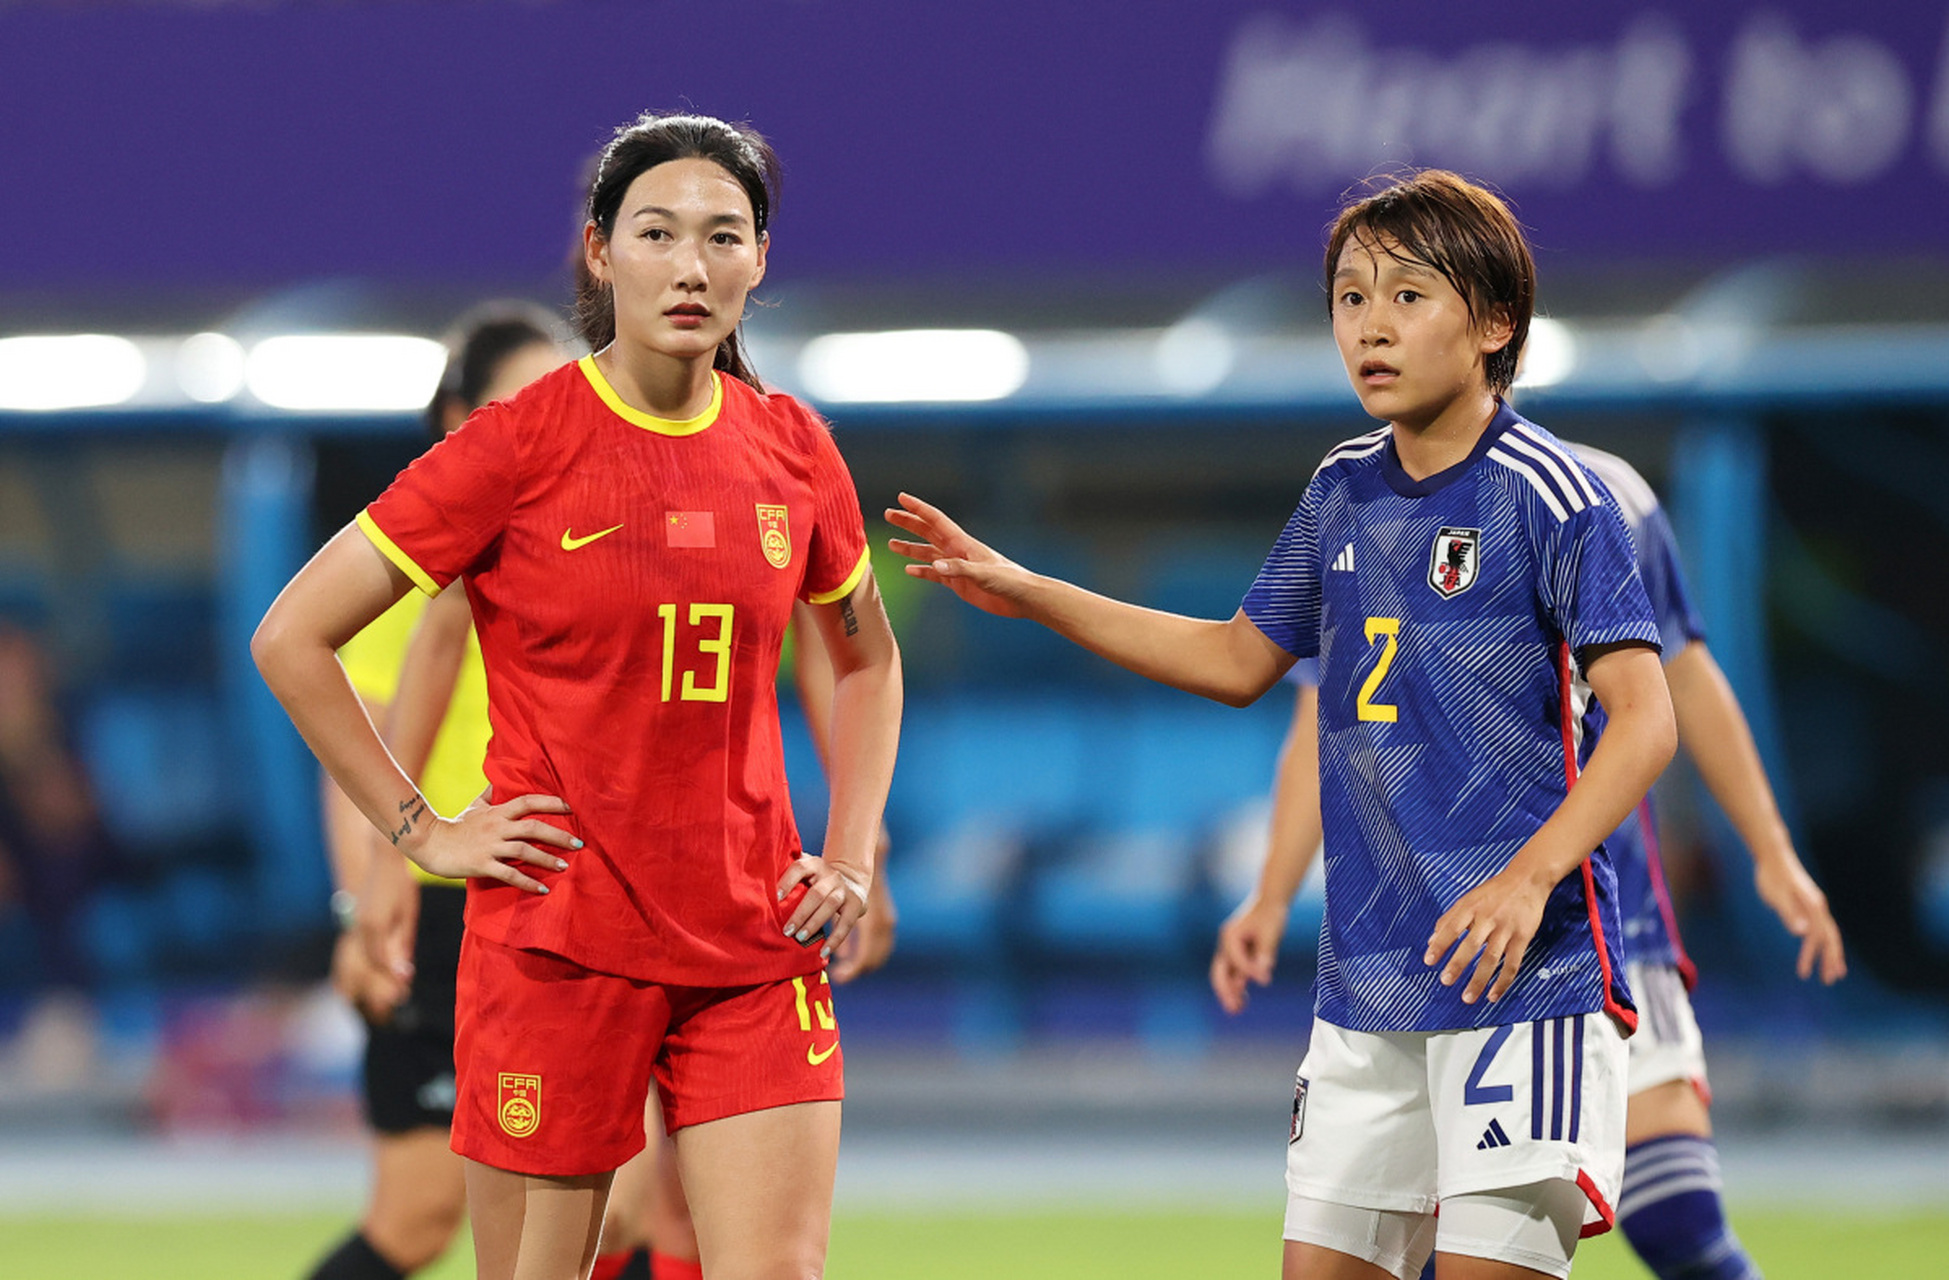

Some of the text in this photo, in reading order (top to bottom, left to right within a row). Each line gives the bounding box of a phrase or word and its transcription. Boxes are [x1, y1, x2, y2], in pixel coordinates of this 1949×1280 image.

[1726, 22, 1908, 184] to
[760, 509, 785, 521] CFA
[658, 603, 734, 702] 13
[1357, 617, 1399, 722] 2
[502, 1077, 537, 1090] CFA
[1464, 1024, 1513, 1105] 2
